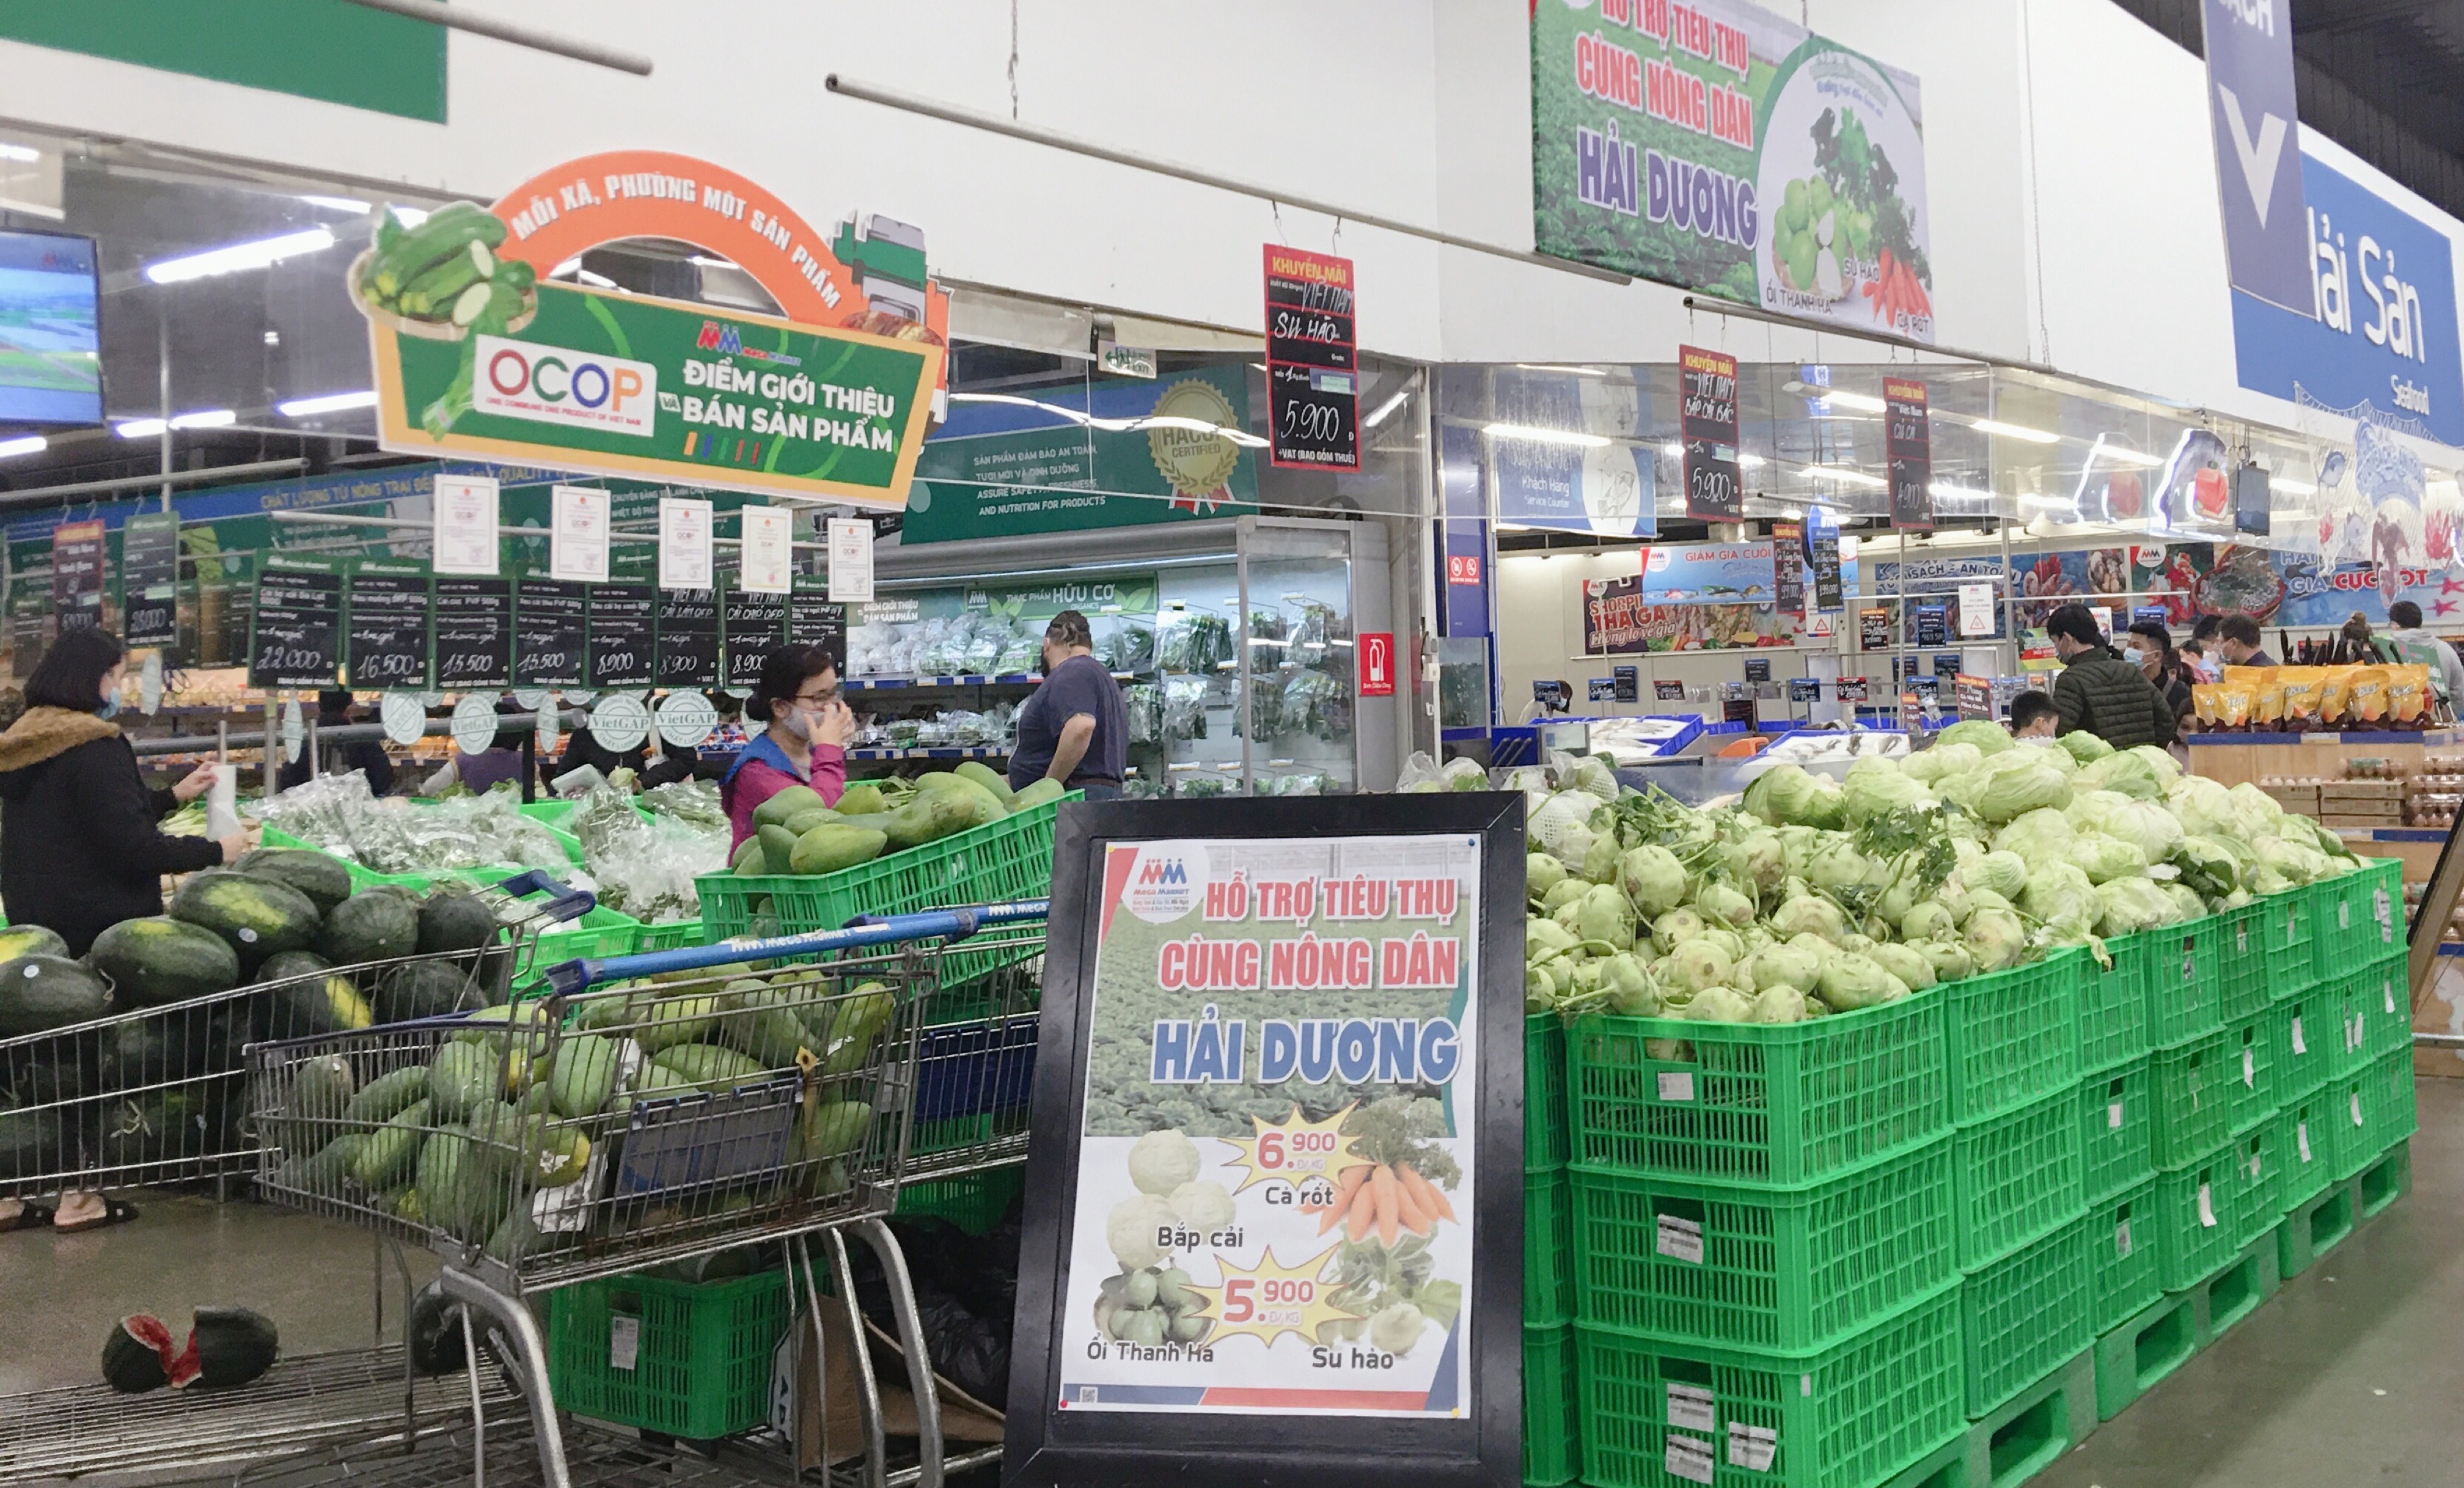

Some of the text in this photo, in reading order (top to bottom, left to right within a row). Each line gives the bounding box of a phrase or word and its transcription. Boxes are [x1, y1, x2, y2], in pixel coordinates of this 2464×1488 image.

[1673, 1, 1711, 59] TIÊU
[1714, 23, 1749, 82] THỤ
[1575, 29, 1643, 111] CÙNG
[1647, 56, 1707, 134] NÔNG
[1711, 78, 1753, 151] DÂN
[1577, 117, 1759, 249] HẢI DƯƠNG
[511, 194, 559, 241] MỖI
[604, 170, 696, 202] PHƯỜNG
[703, 186, 747, 221] MỘT
[750, 209, 791, 252] SẢN
[791, 244, 842, 309] PHẨM
[1273, 255, 1346, 284] KHUYẾN MÃI
[1780, 289, 1814, 311] THANH
[2358, 235, 2425, 364] Sản
[1275, 312, 1302, 340] SU
[1685, 354, 1717, 372] KHUYẾN
[489, 348, 642, 412] OCOP
[683, 356, 756, 395] ĐIỂM
[760, 373, 815, 405] GIỚI
[2390, 374, 2430, 416] Seafood
[562, 408, 596, 420] PRODUCT
[626, 417, 642, 426] NAM
[683, 394, 893, 452] BÁN SẢN PHẨM
[1281, 399, 1339, 442] 5.900
[974, 454, 991, 466] SẢN
[992, 450, 1016, 464] PHẨM
[1058, 447, 1070, 457] AN
[1172, 444, 1221, 458] CERTIFIED
[1015, 469, 1026, 478] VÀ
[1692, 467, 1730, 502] 5.900
[977, 488, 1008, 499] ASSURE
[978, 496, 1106, 516] AND NUTRITION FOR PRODUCTS
[1548, 496, 1570, 508] Counter
[1960, 563, 1978, 574] AN
[1052, 582, 1087, 604] HỮU
[1093, 584, 1116, 601] CƠ
[593, 716, 648, 730] VietGAP
[658, 713, 715, 724] VietGAP
[1207, 870, 1456, 924] HỖ TRỢ TIÊU THỤ
[1160, 932, 1456, 987] CÙNG NÔNG DÂN
[1153, 1005, 1459, 1083] HẢI DƯƠNG
[1265, 1184, 1333, 1205] Cà rốt
[1157, 1222, 1244, 1252] Bắp cải
[1087, 1333, 1113, 1360] Ổi
[1116, 1341, 1180, 1363] Thanh
[1313, 1347, 1395, 1370] Su hào
